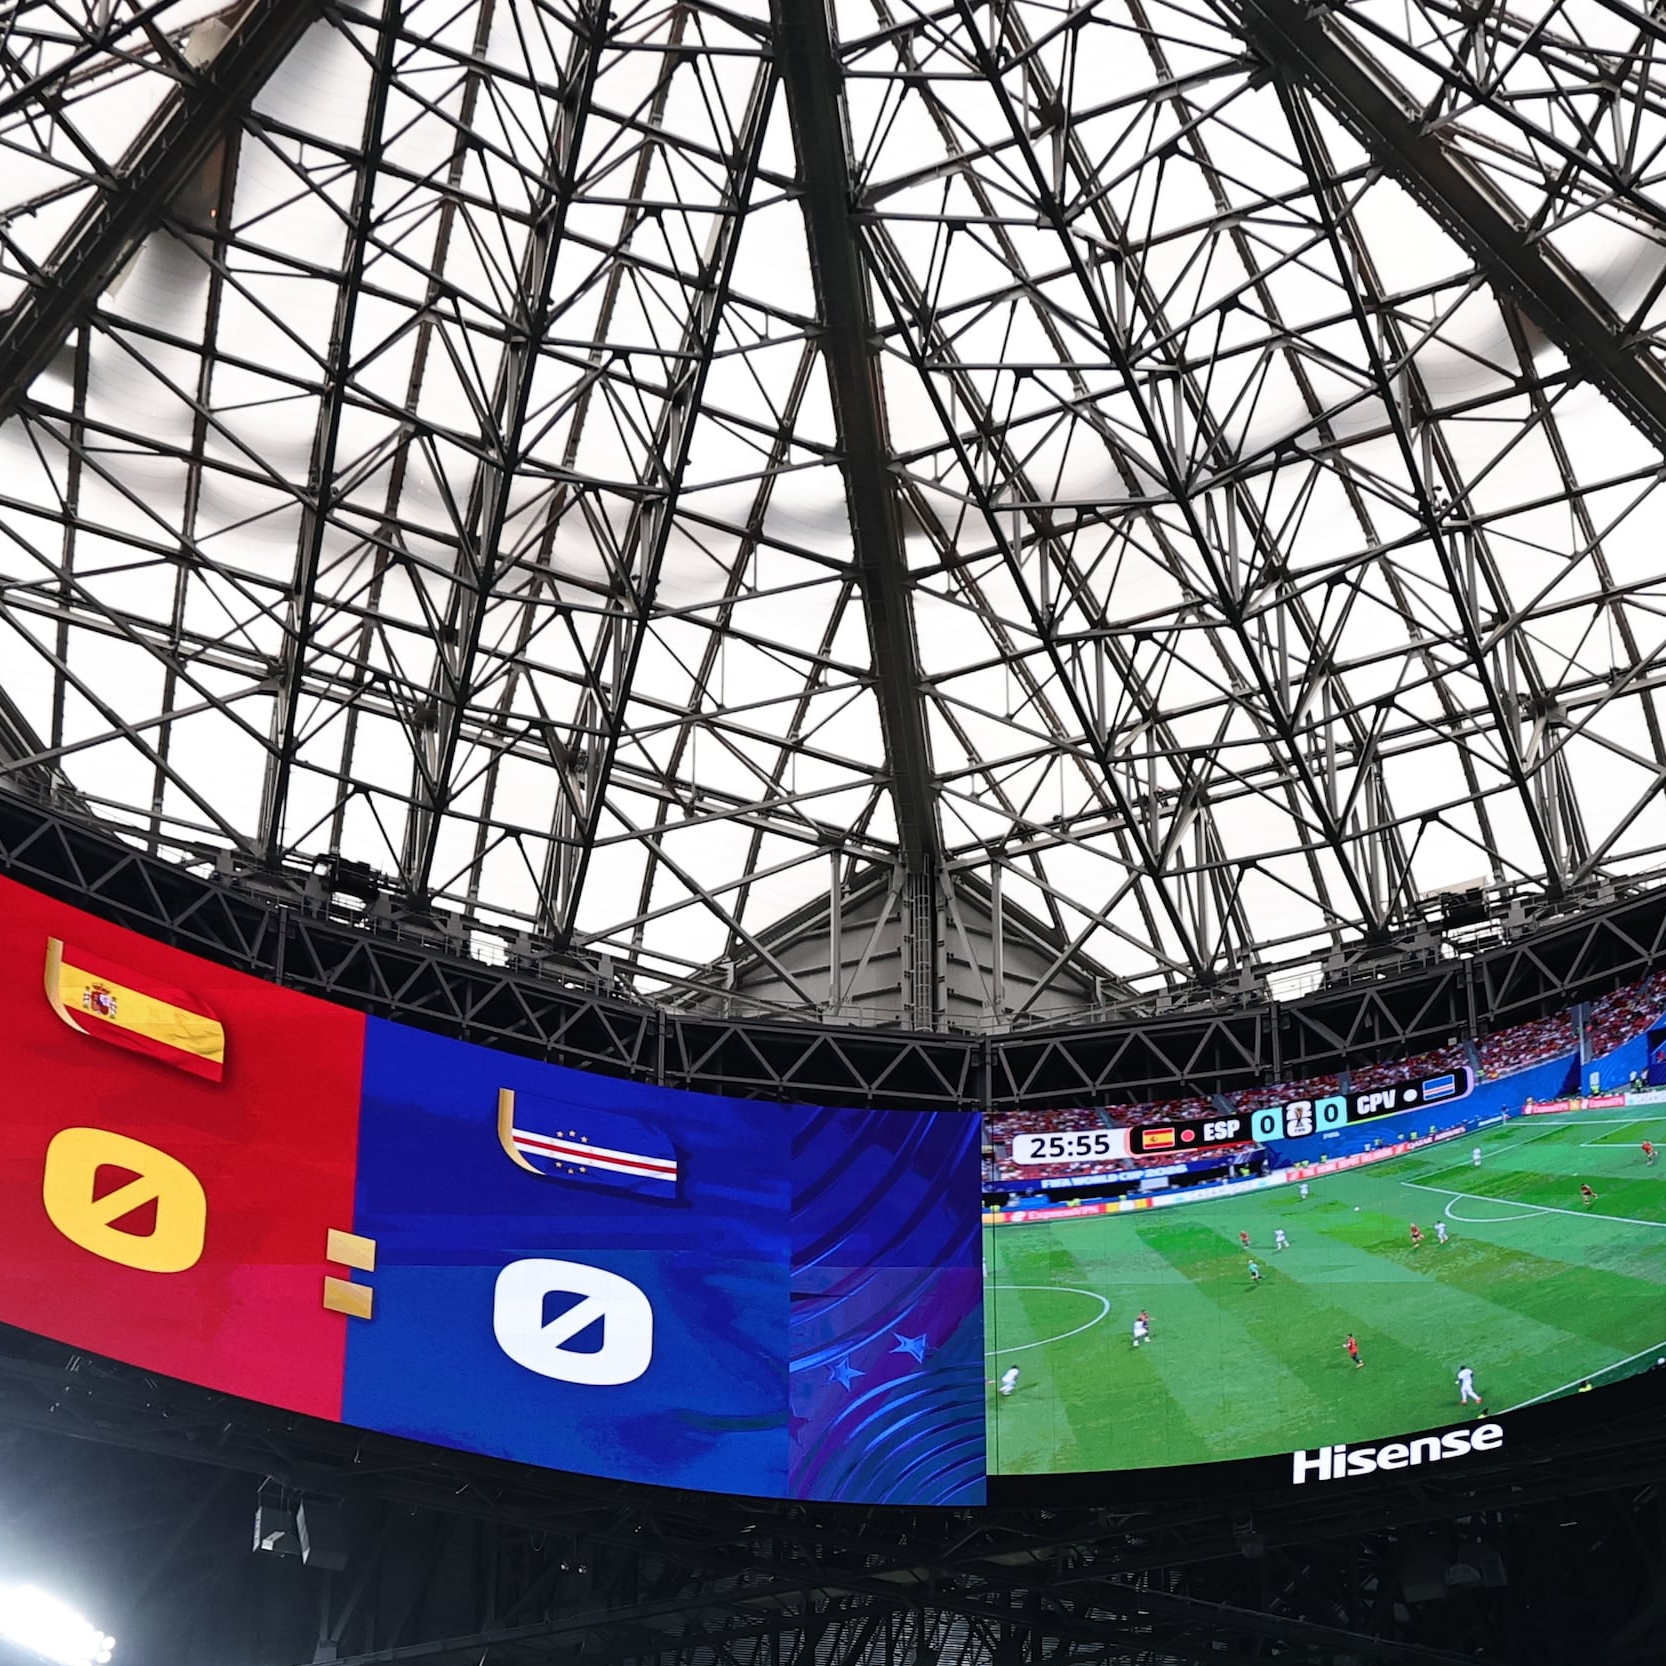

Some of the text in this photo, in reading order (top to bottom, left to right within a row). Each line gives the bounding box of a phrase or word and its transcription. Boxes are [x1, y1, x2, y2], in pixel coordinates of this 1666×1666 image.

[1203, 1089, 1396, 1141] ESP 0 0 CPV
[1030, 1133, 1111, 1158] 25:55
[1293, 1423, 1503, 1484] Hisense
